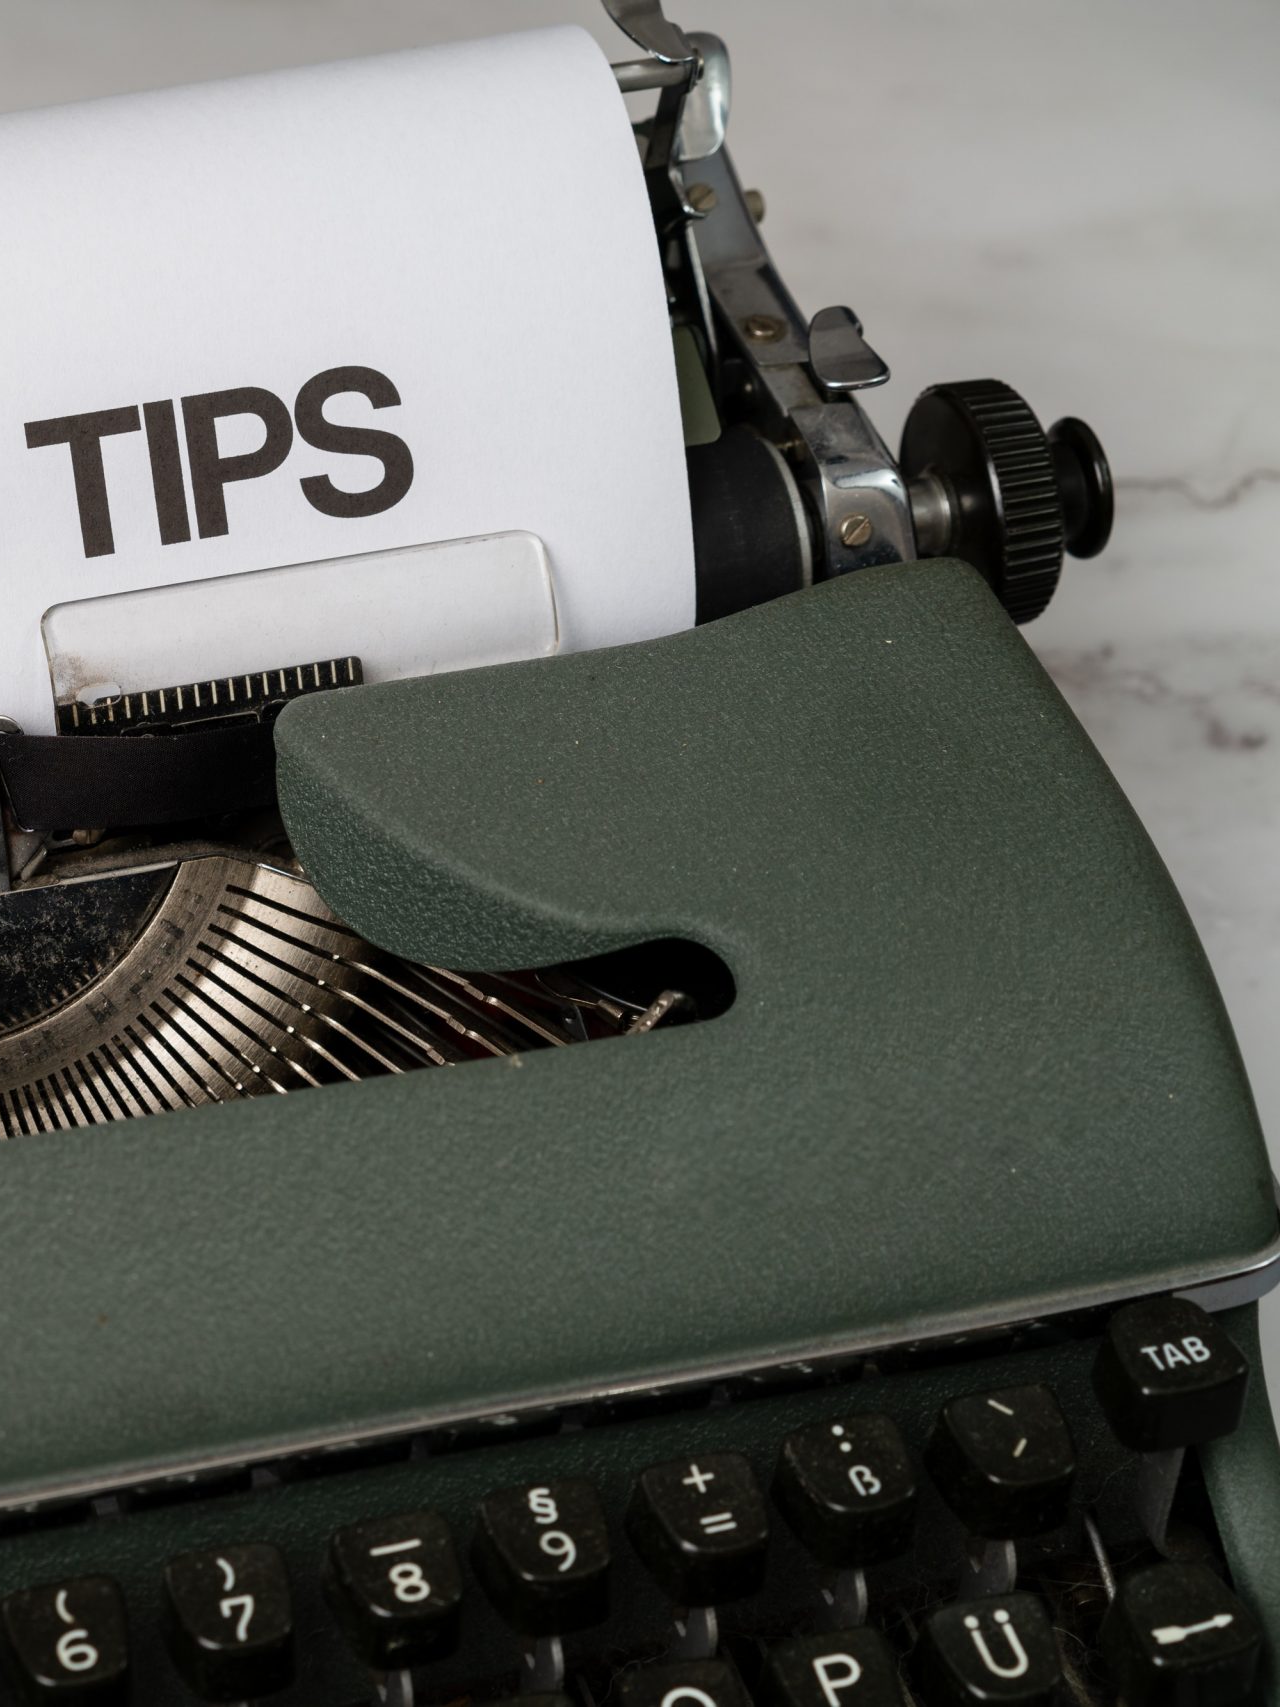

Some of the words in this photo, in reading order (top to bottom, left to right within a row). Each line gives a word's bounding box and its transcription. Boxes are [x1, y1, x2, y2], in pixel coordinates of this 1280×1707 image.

[23, 365, 414, 559] TIPS
[1140, 1336, 1211, 1371] TAB
[682, 1464, 715, 1493] +
[528, 1487, 559, 1524] §
[700, 1512, 737, 1534] =
[540, 1530, 577, 1572] 9
[216, 1558, 235, 1591] )
[389, 1562, 431, 1603] 8
[55, 1590, 73, 1623] (
[220, 1594, 254, 1641] 7
[56, 1629, 98, 1671] 6
[963, 1609, 1029, 1678] Ü
[812, 1653, 861, 1707] P
